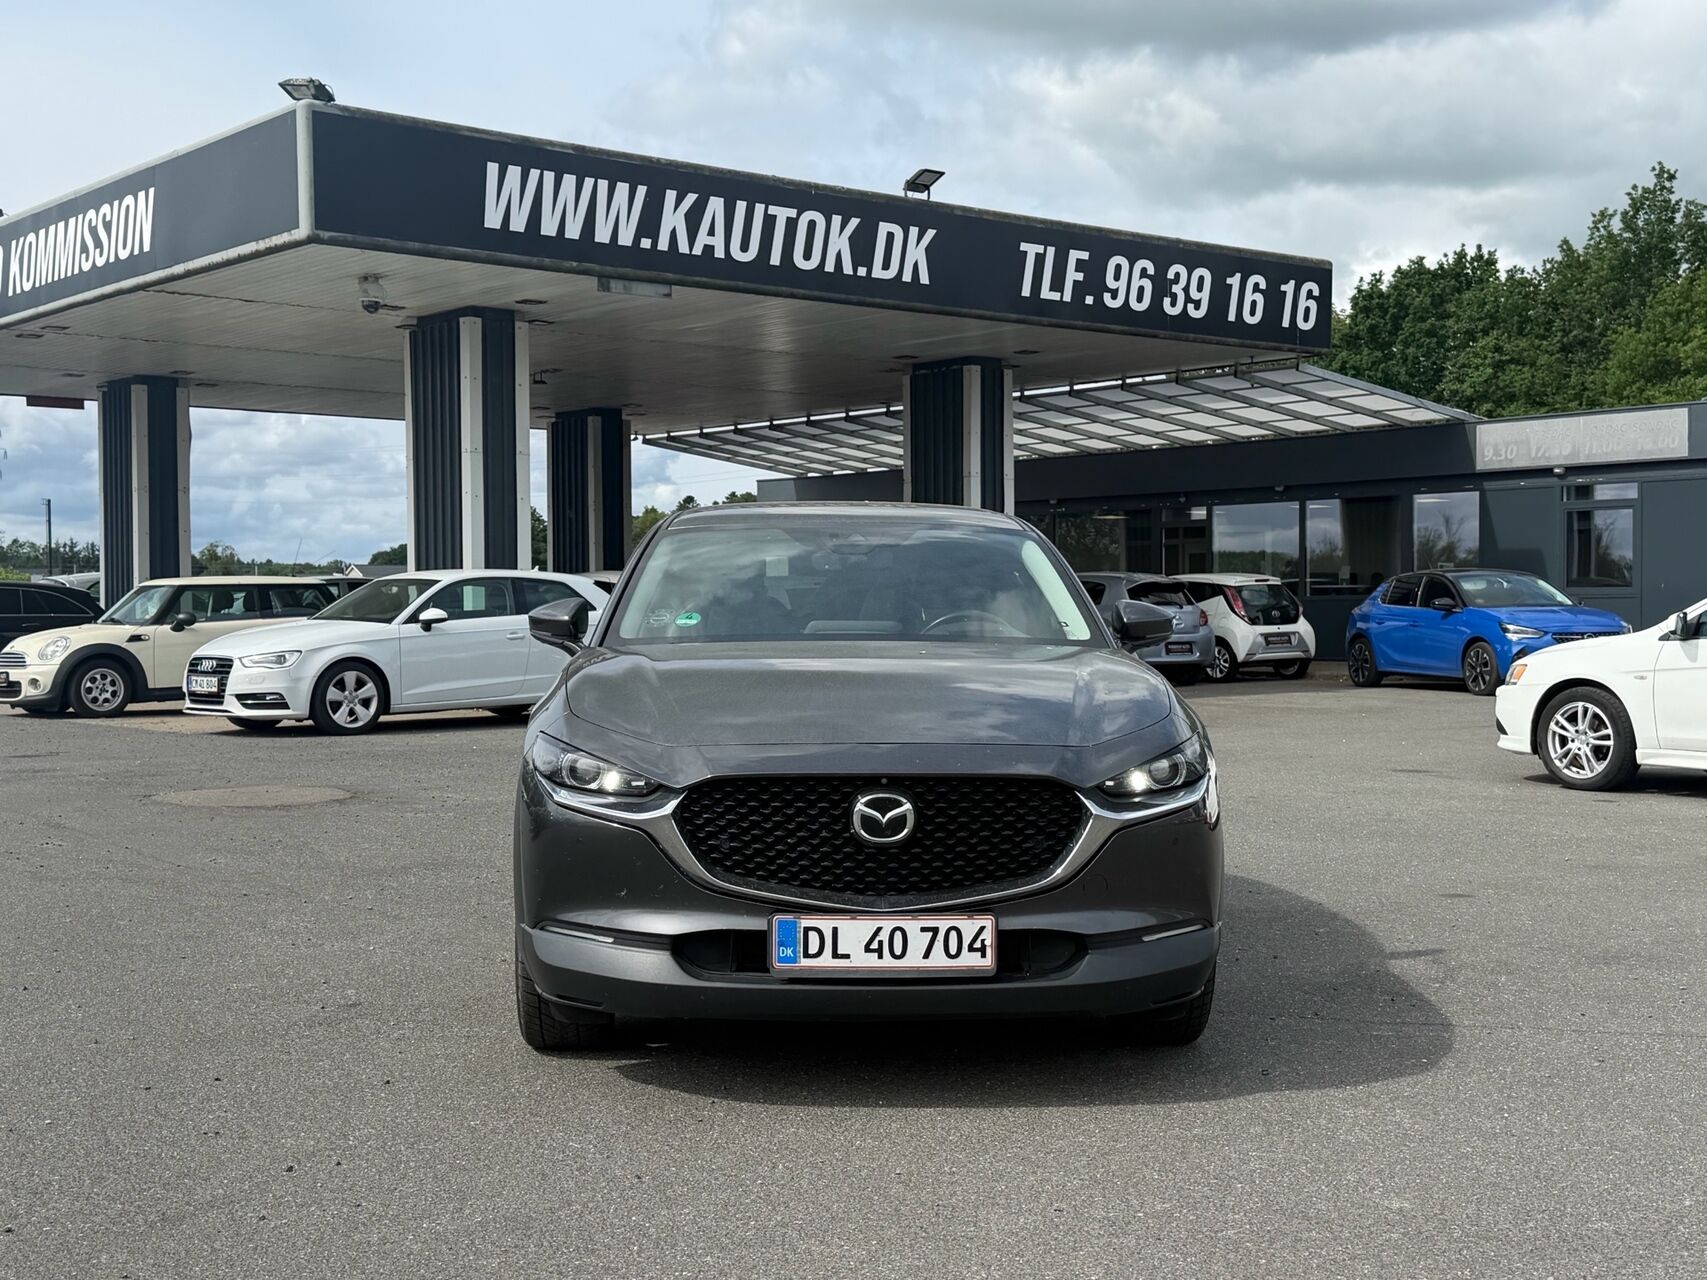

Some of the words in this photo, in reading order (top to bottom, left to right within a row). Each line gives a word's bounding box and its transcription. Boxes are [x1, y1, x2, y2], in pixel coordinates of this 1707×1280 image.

[8, 187, 155, 297] KOMMISSION
[483, 161, 937, 285] WWW.KAUTOK.DK
[1019, 242, 1094, 305] TLF.
[1103, 255, 1155, 312] 96
[1163, 263, 1212, 319] 39
[1226, 272, 1267, 325] 16
[1280, 279, 1320, 331] 16
[779, 947, 794, 957] DK
[802, 926, 850, 959] DL
[864, 926, 908, 959] 40
[920, 926, 987, 959] 704
